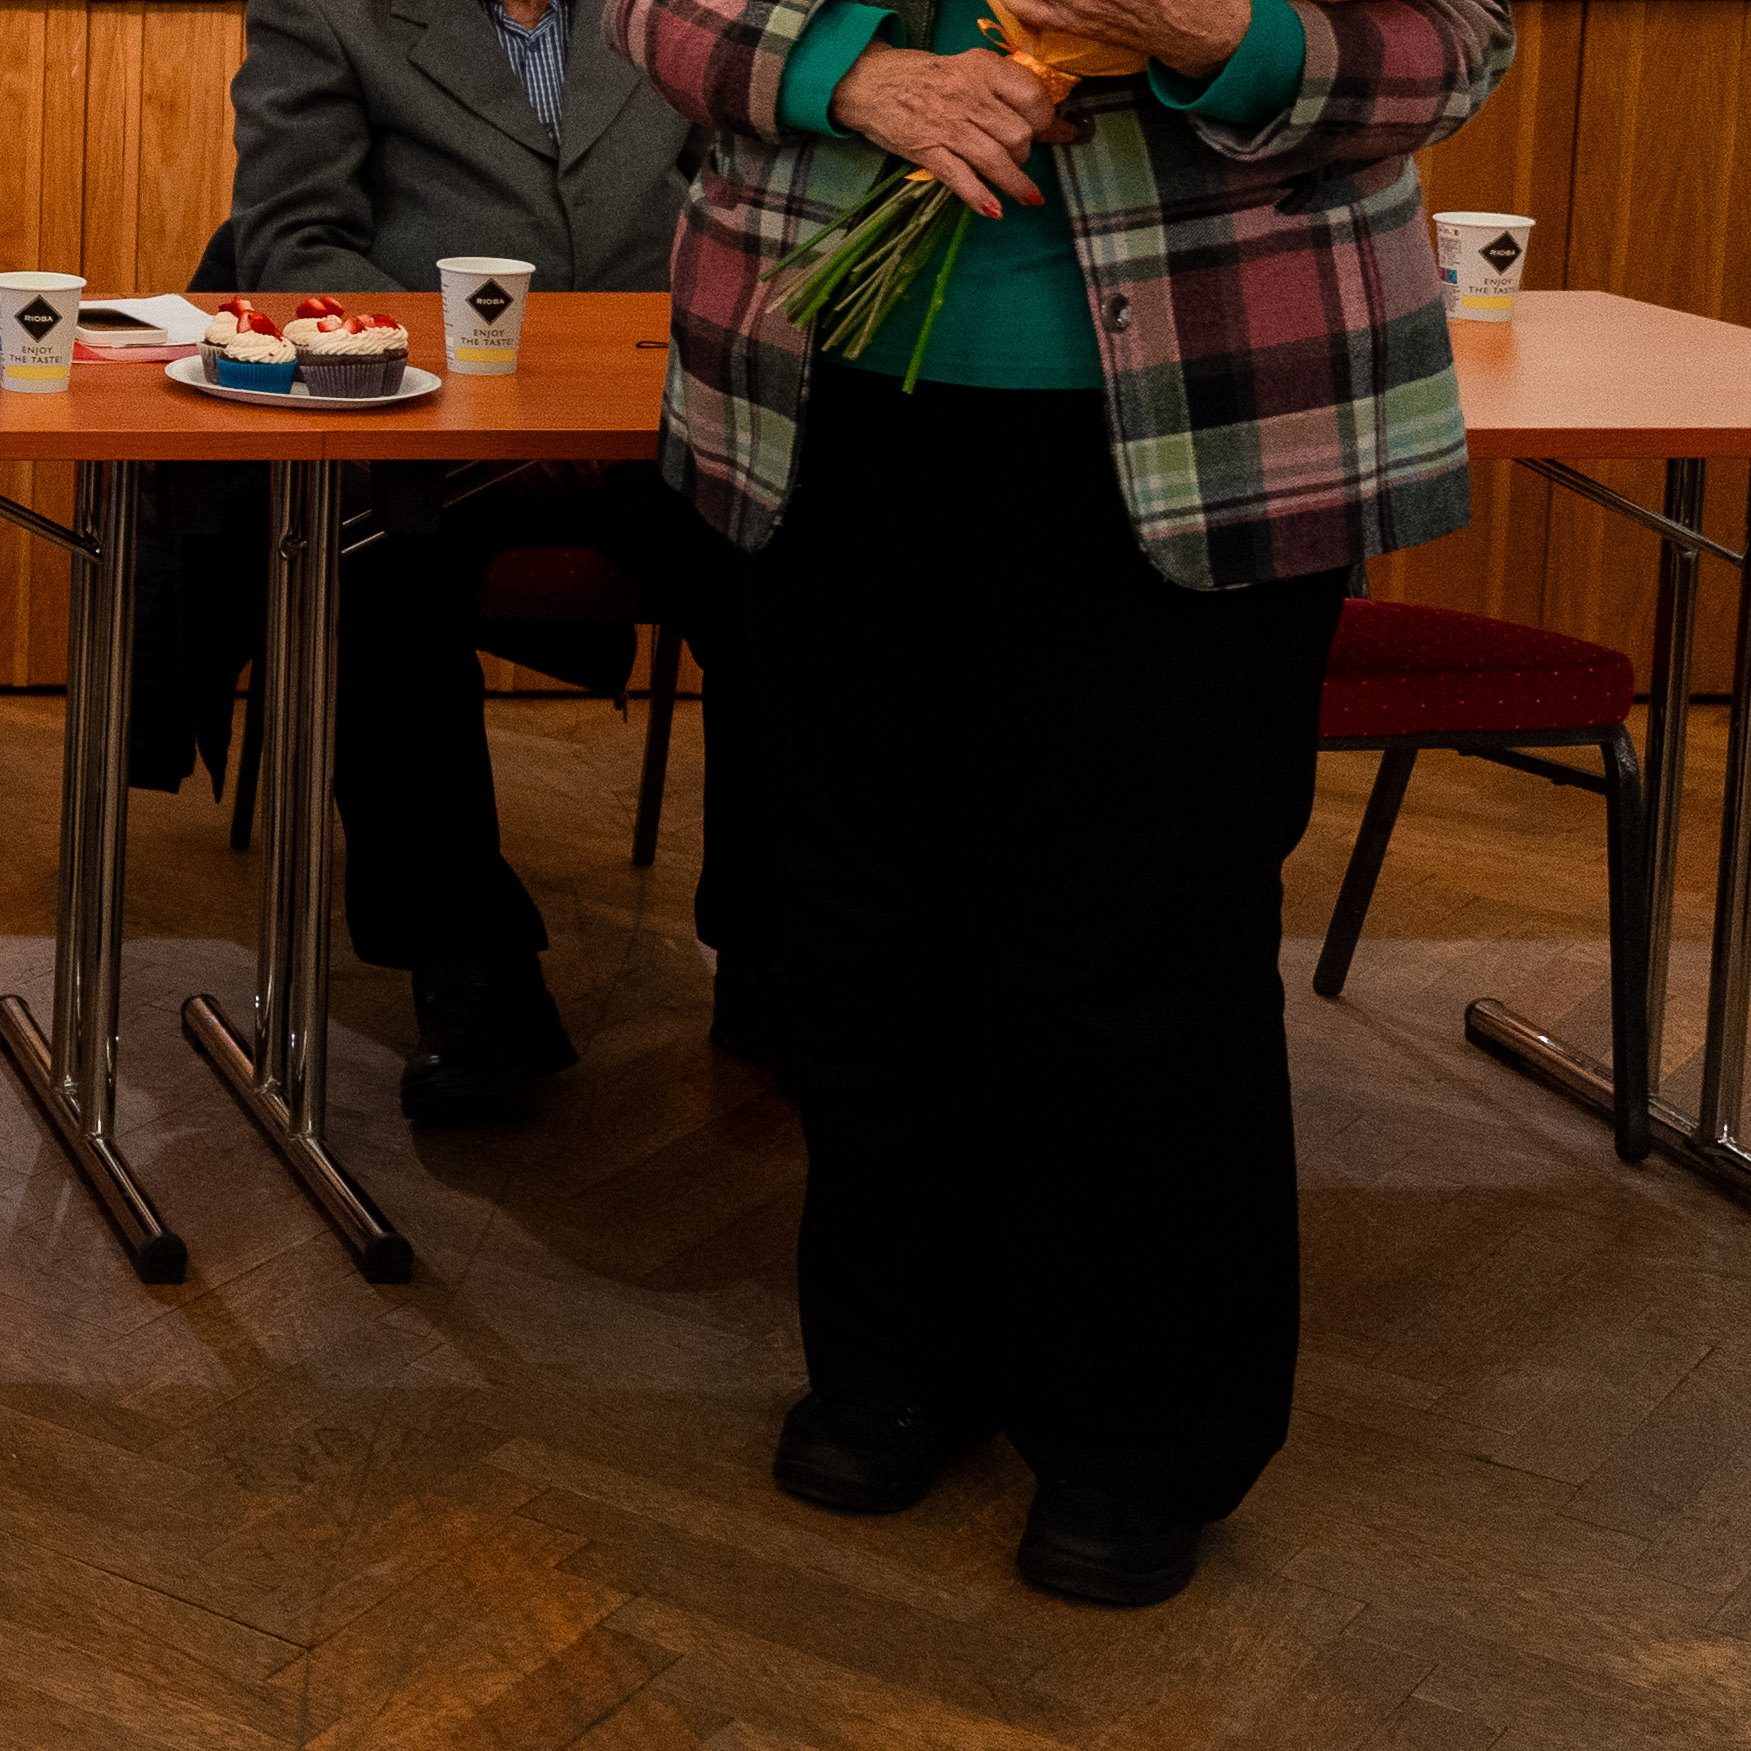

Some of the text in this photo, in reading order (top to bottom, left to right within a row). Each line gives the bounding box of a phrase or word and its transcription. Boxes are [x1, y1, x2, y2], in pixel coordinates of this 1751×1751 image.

[24, 314, 53, 322] RIOBA
[473, 329, 504, 338] ENJOY
[460, 337, 479, 345] THE
[21, 346, 53, 355] ENJOY
[9, 354, 26, 363] THE
